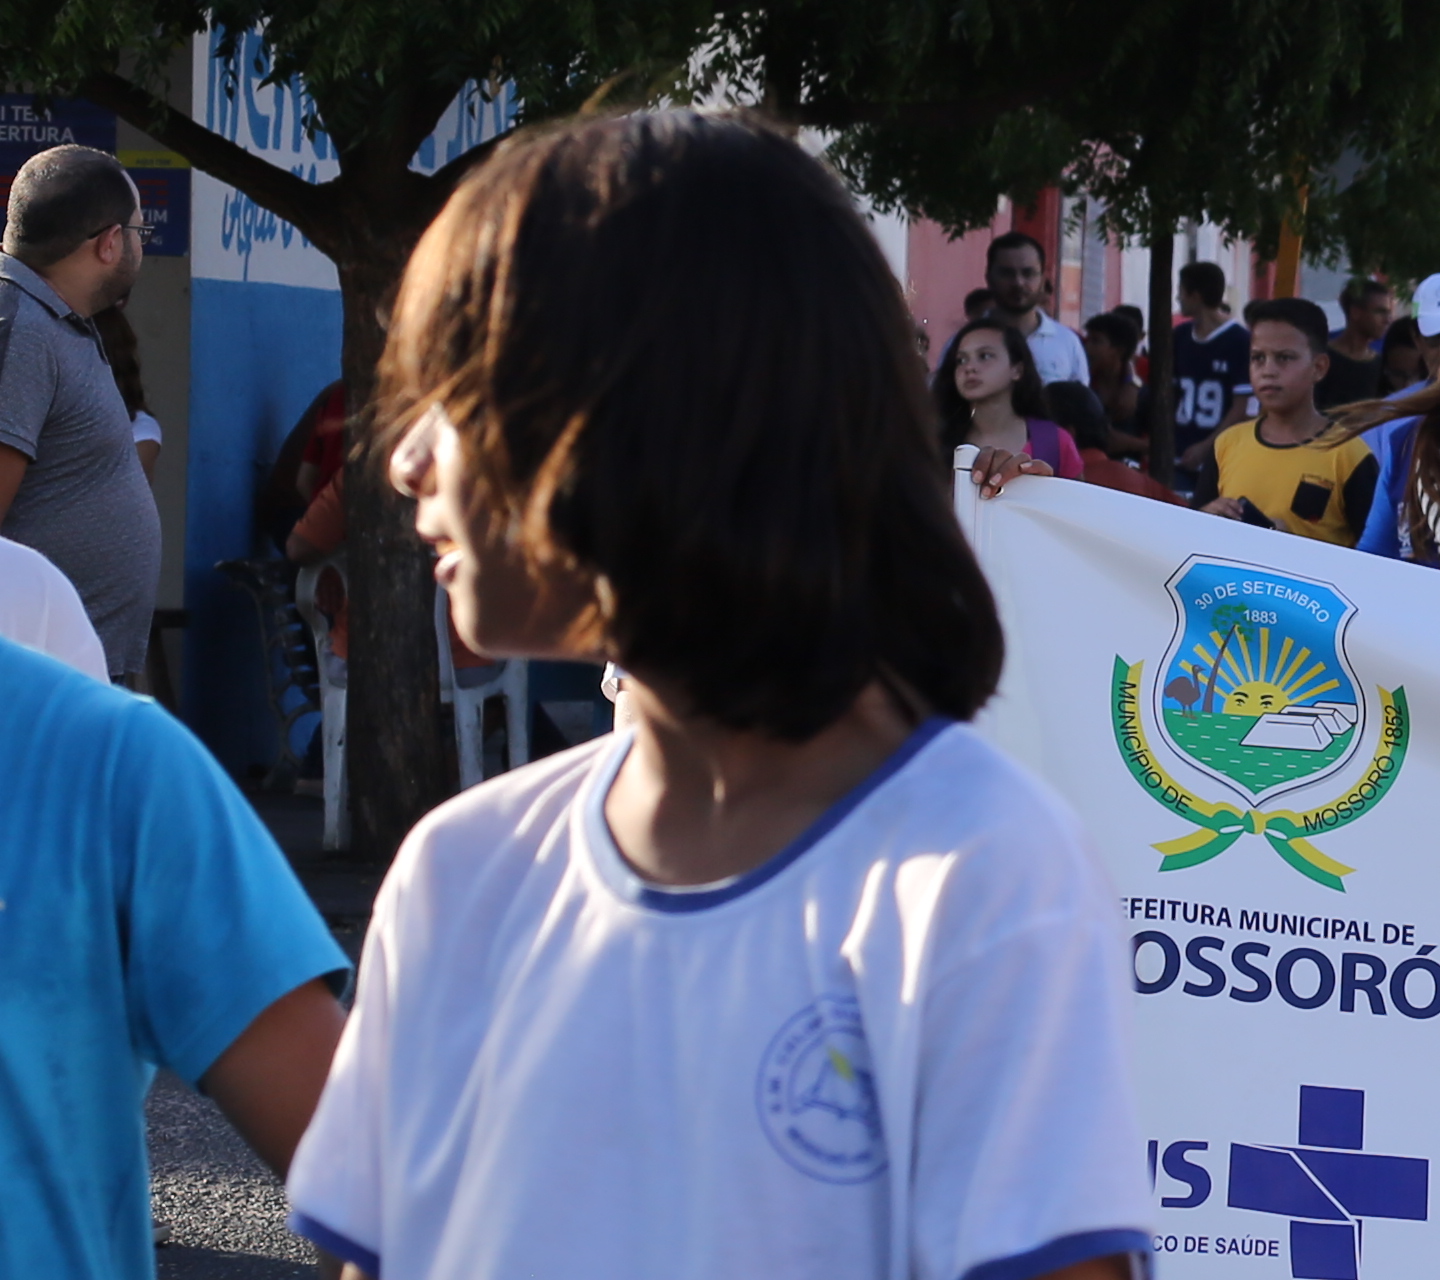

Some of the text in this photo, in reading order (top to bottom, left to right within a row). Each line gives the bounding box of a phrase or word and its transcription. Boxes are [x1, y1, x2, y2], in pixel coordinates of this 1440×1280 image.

[1194, 580, 1330, 624] 30 DE SETEMBRO
[1243, 609, 1278, 625] 1883
[1116, 680, 1193, 815] MUNICÍPIO DE
[1302, 704, 1404, 833] MOSSORÓ 1852
[1122, 896, 1416, 947] FEITURA MUNICIPAL DE
[1183, 1235, 1210, 1254] DE
[1214, 1233, 1281, 1258] SAÚDE
